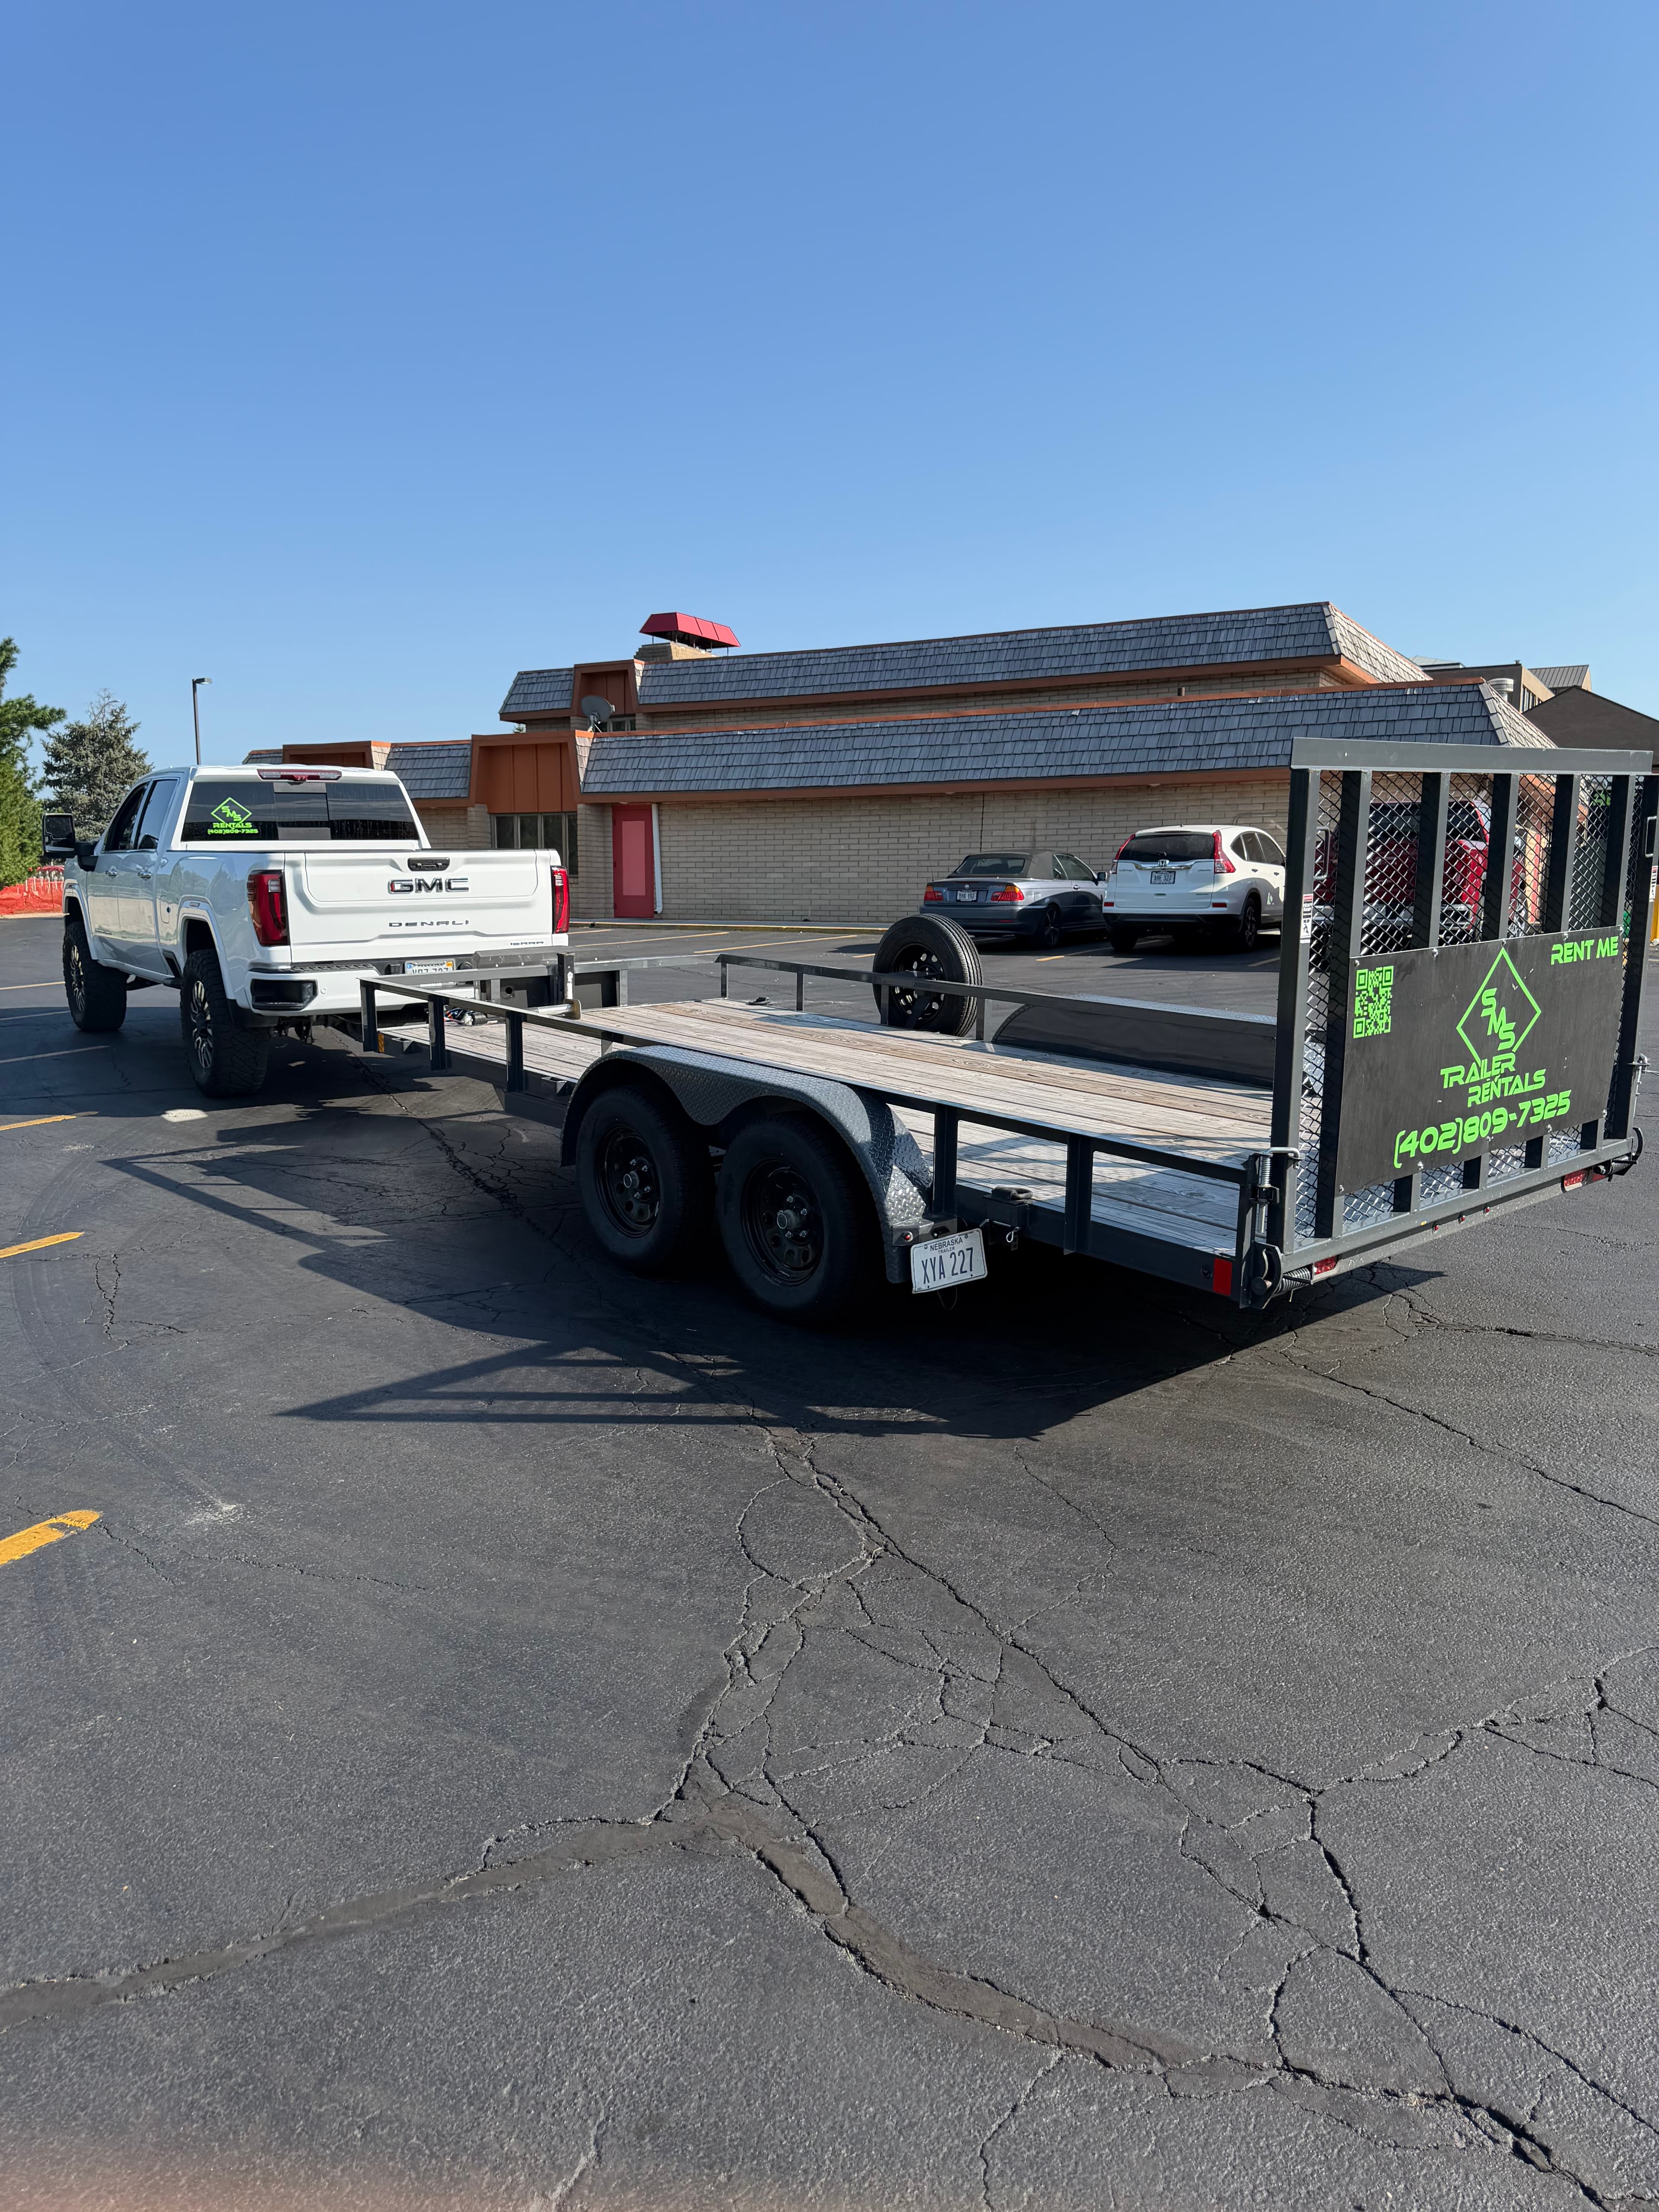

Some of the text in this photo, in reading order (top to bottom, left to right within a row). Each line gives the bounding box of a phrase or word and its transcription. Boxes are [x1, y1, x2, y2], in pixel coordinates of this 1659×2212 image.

[221, 806, 242, 821] SMS
[387, 877, 469, 894] GMC
[1551, 936, 1619, 965] RENT ME
[1481, 988, 1516, 1051] SMS
[1440, 1052, 1516, 1089] TRAILER
[1467, 1069, 1546, 1108] RENTALS
[1394, 1090, 1571, 1168] (402)809-7325
[930, 1237, 963, 1252] NEBRASKA
[938, 1246, 955, 1254] TRAILER
[922, 1247, 973, 1284] XYA 227
